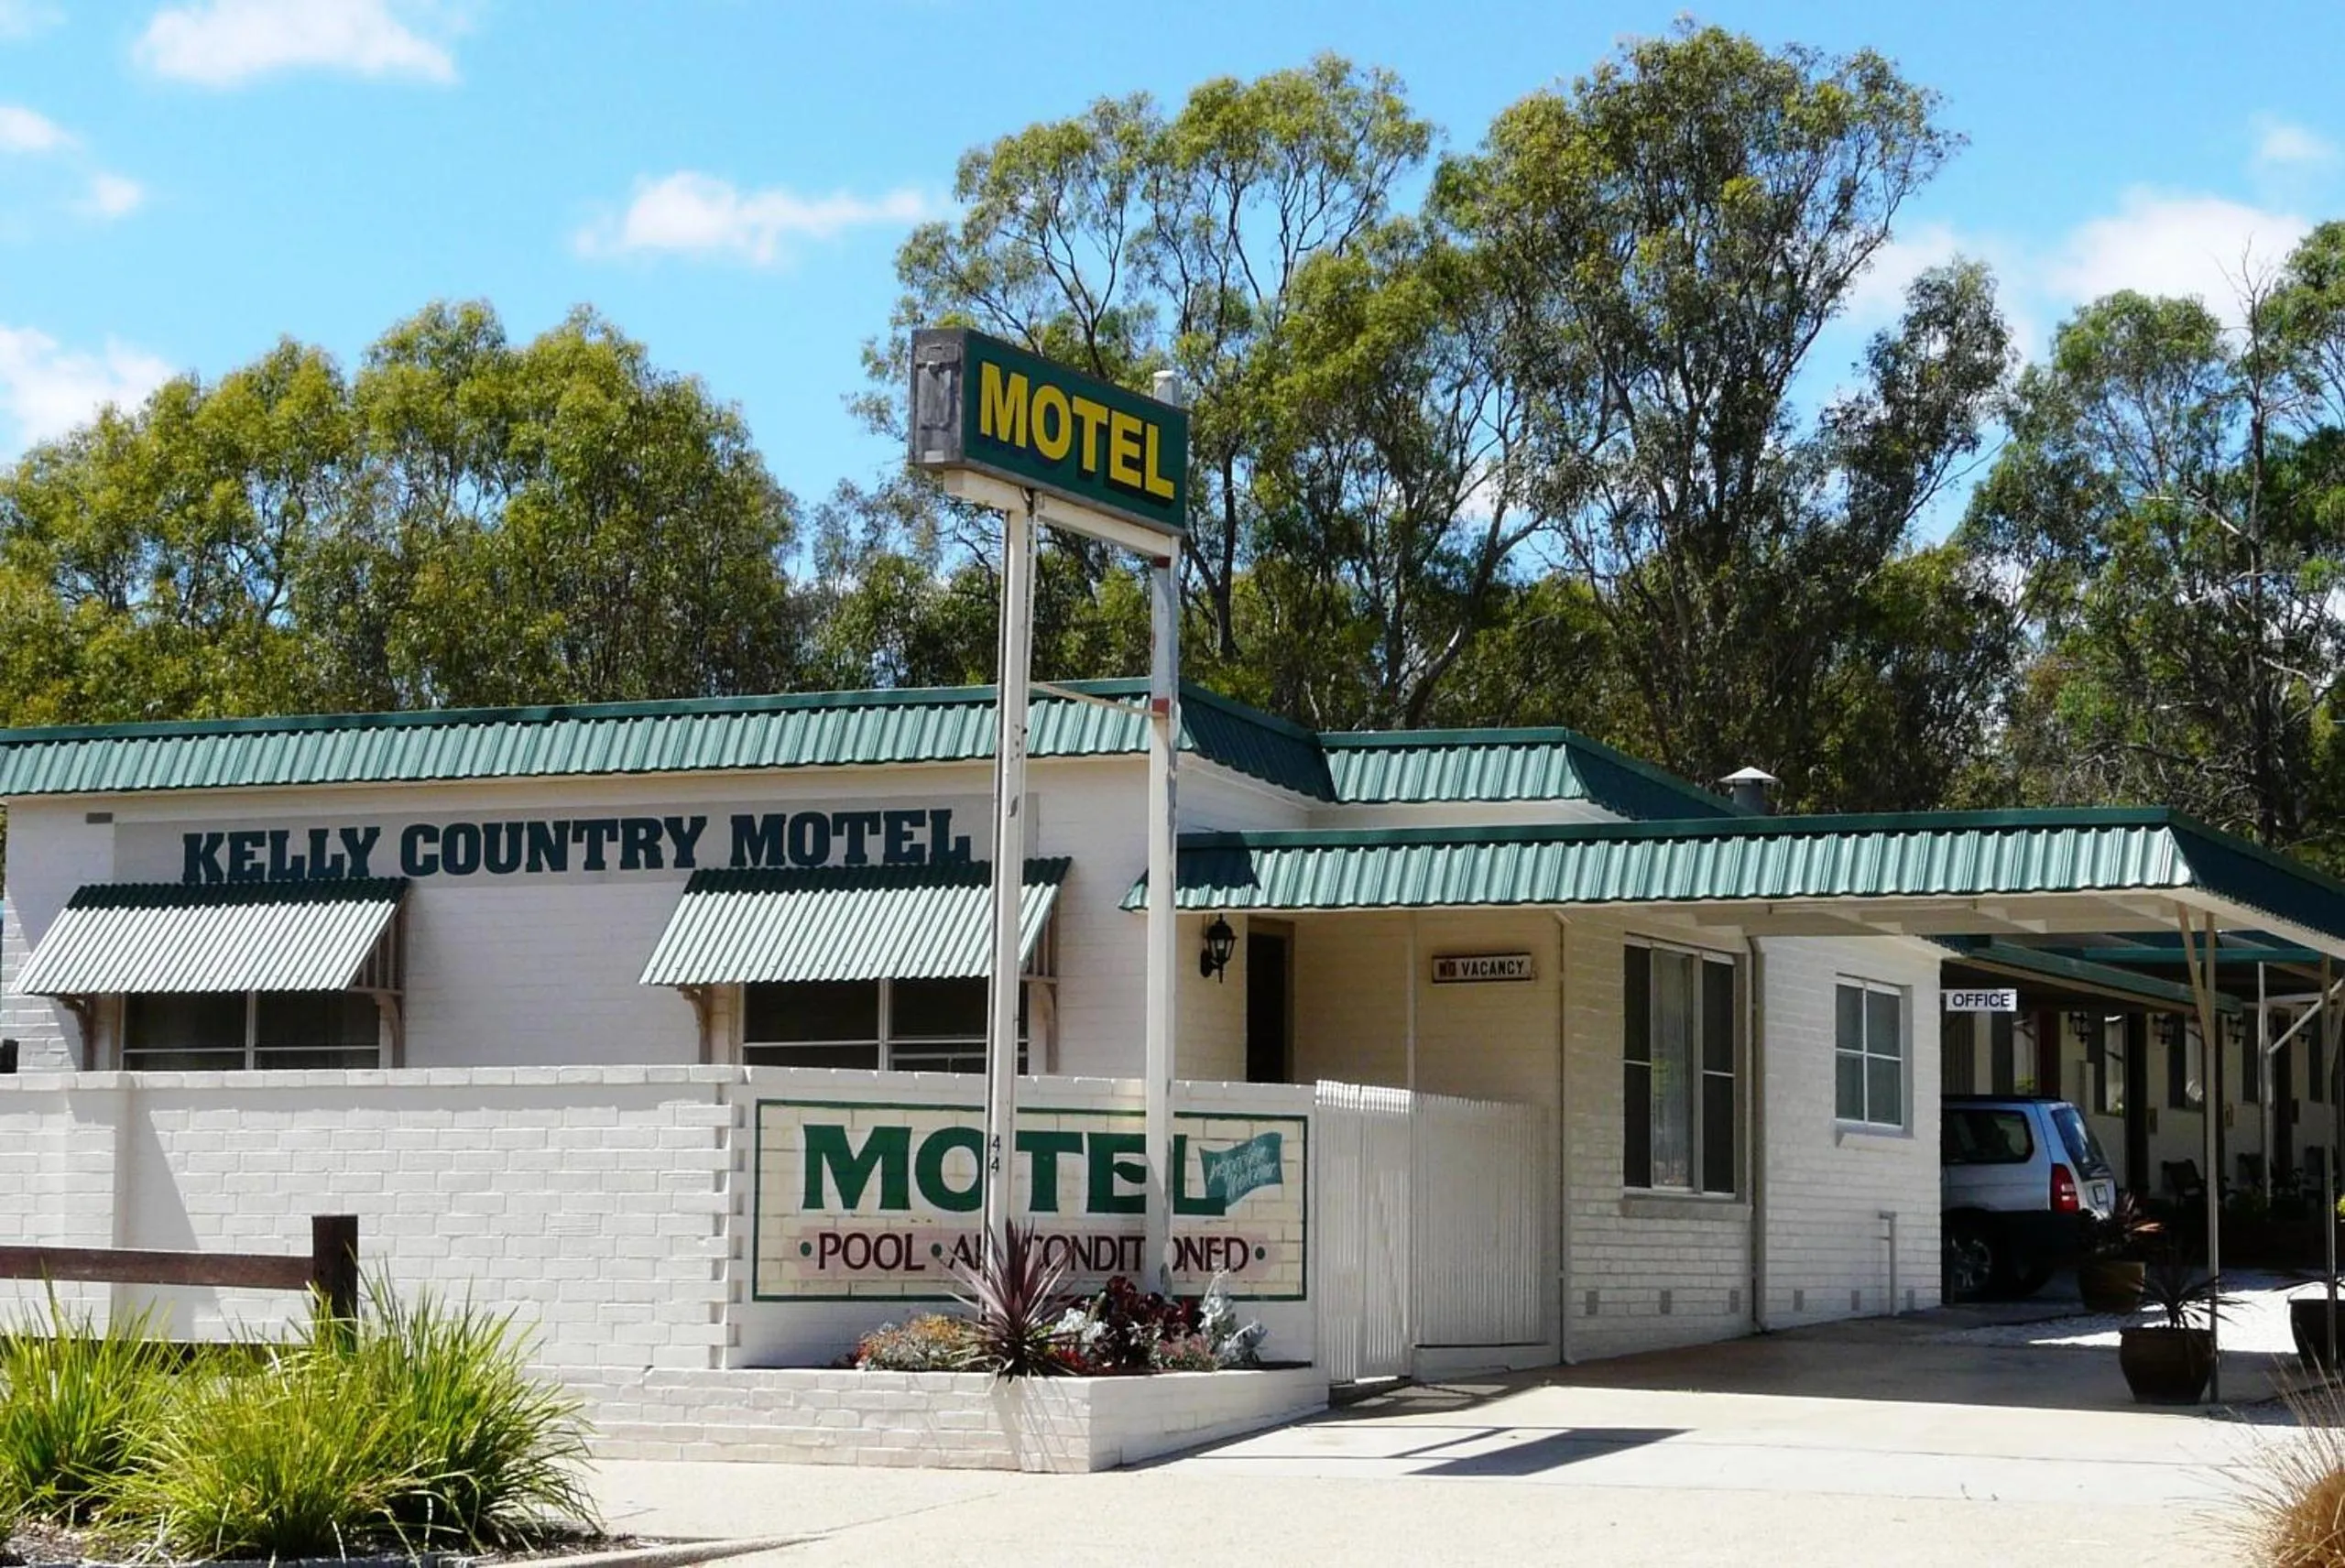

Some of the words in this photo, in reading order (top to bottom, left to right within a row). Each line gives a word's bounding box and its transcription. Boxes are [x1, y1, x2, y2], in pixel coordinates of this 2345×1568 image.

[980, 361, 1175, 500] MOTEL
[182, 826, 381, 880] KELLY
[399, 815, 708, 877] COUNTRY
[729, 809, 971, 867] MOTEL
[1438, 962, 1456, 977] NO
[1461, 960, 1524, 976] VACANCY
[1952, 993, 2011, 1007] OFFICE
[802, 1124, 1226, 1216] MOTEL
[818, 1232, 926, 1271] POOL
